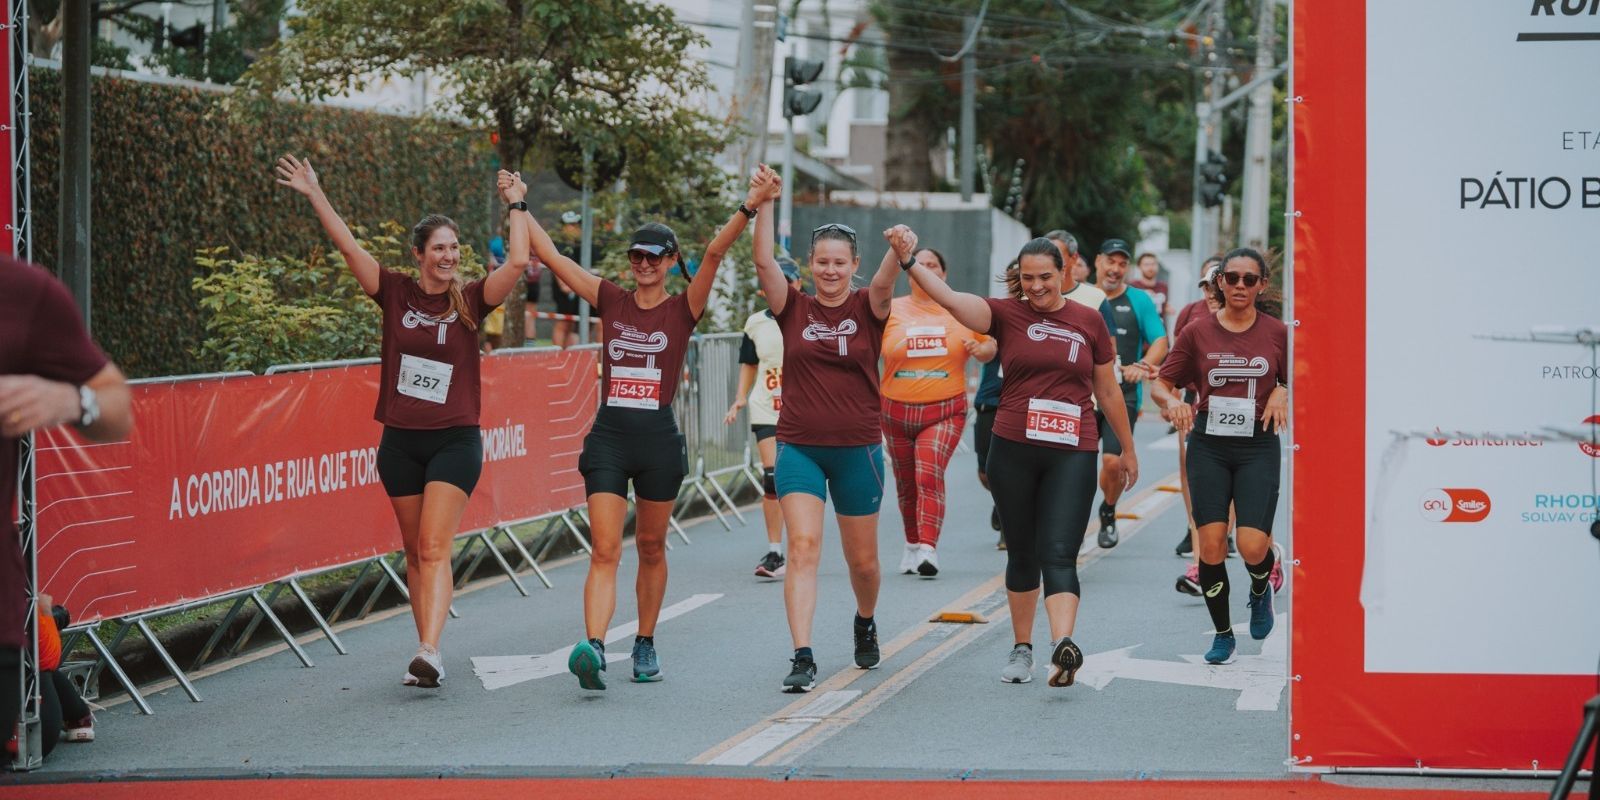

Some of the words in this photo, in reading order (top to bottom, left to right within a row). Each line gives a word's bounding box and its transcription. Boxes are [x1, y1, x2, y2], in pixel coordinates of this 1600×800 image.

[1530, 0, 1600, 16] RU
[1460, 171, 1572, 210] PÁTIO
[917, 338, 943, 349] 5148
[412, 374, 440, 390] 257
[620, 384, 655, 397] 5437
[1040, 416, 1075, 433] 5438
[1219, 413, 1246, 426] 229
[169, 477, 183, 521] A
[186, 465, 261, 519] CORRIDA
[264, 463, 283, 504] DE
[286, 456, 316, 500] RUA
[319, 452, 348, 494] QUE
[1423, 500, 1448, 511] GOL
[1457, 499, 1486, 510] Smiles
[1521, 512, 1576, 523] SOLVAY
